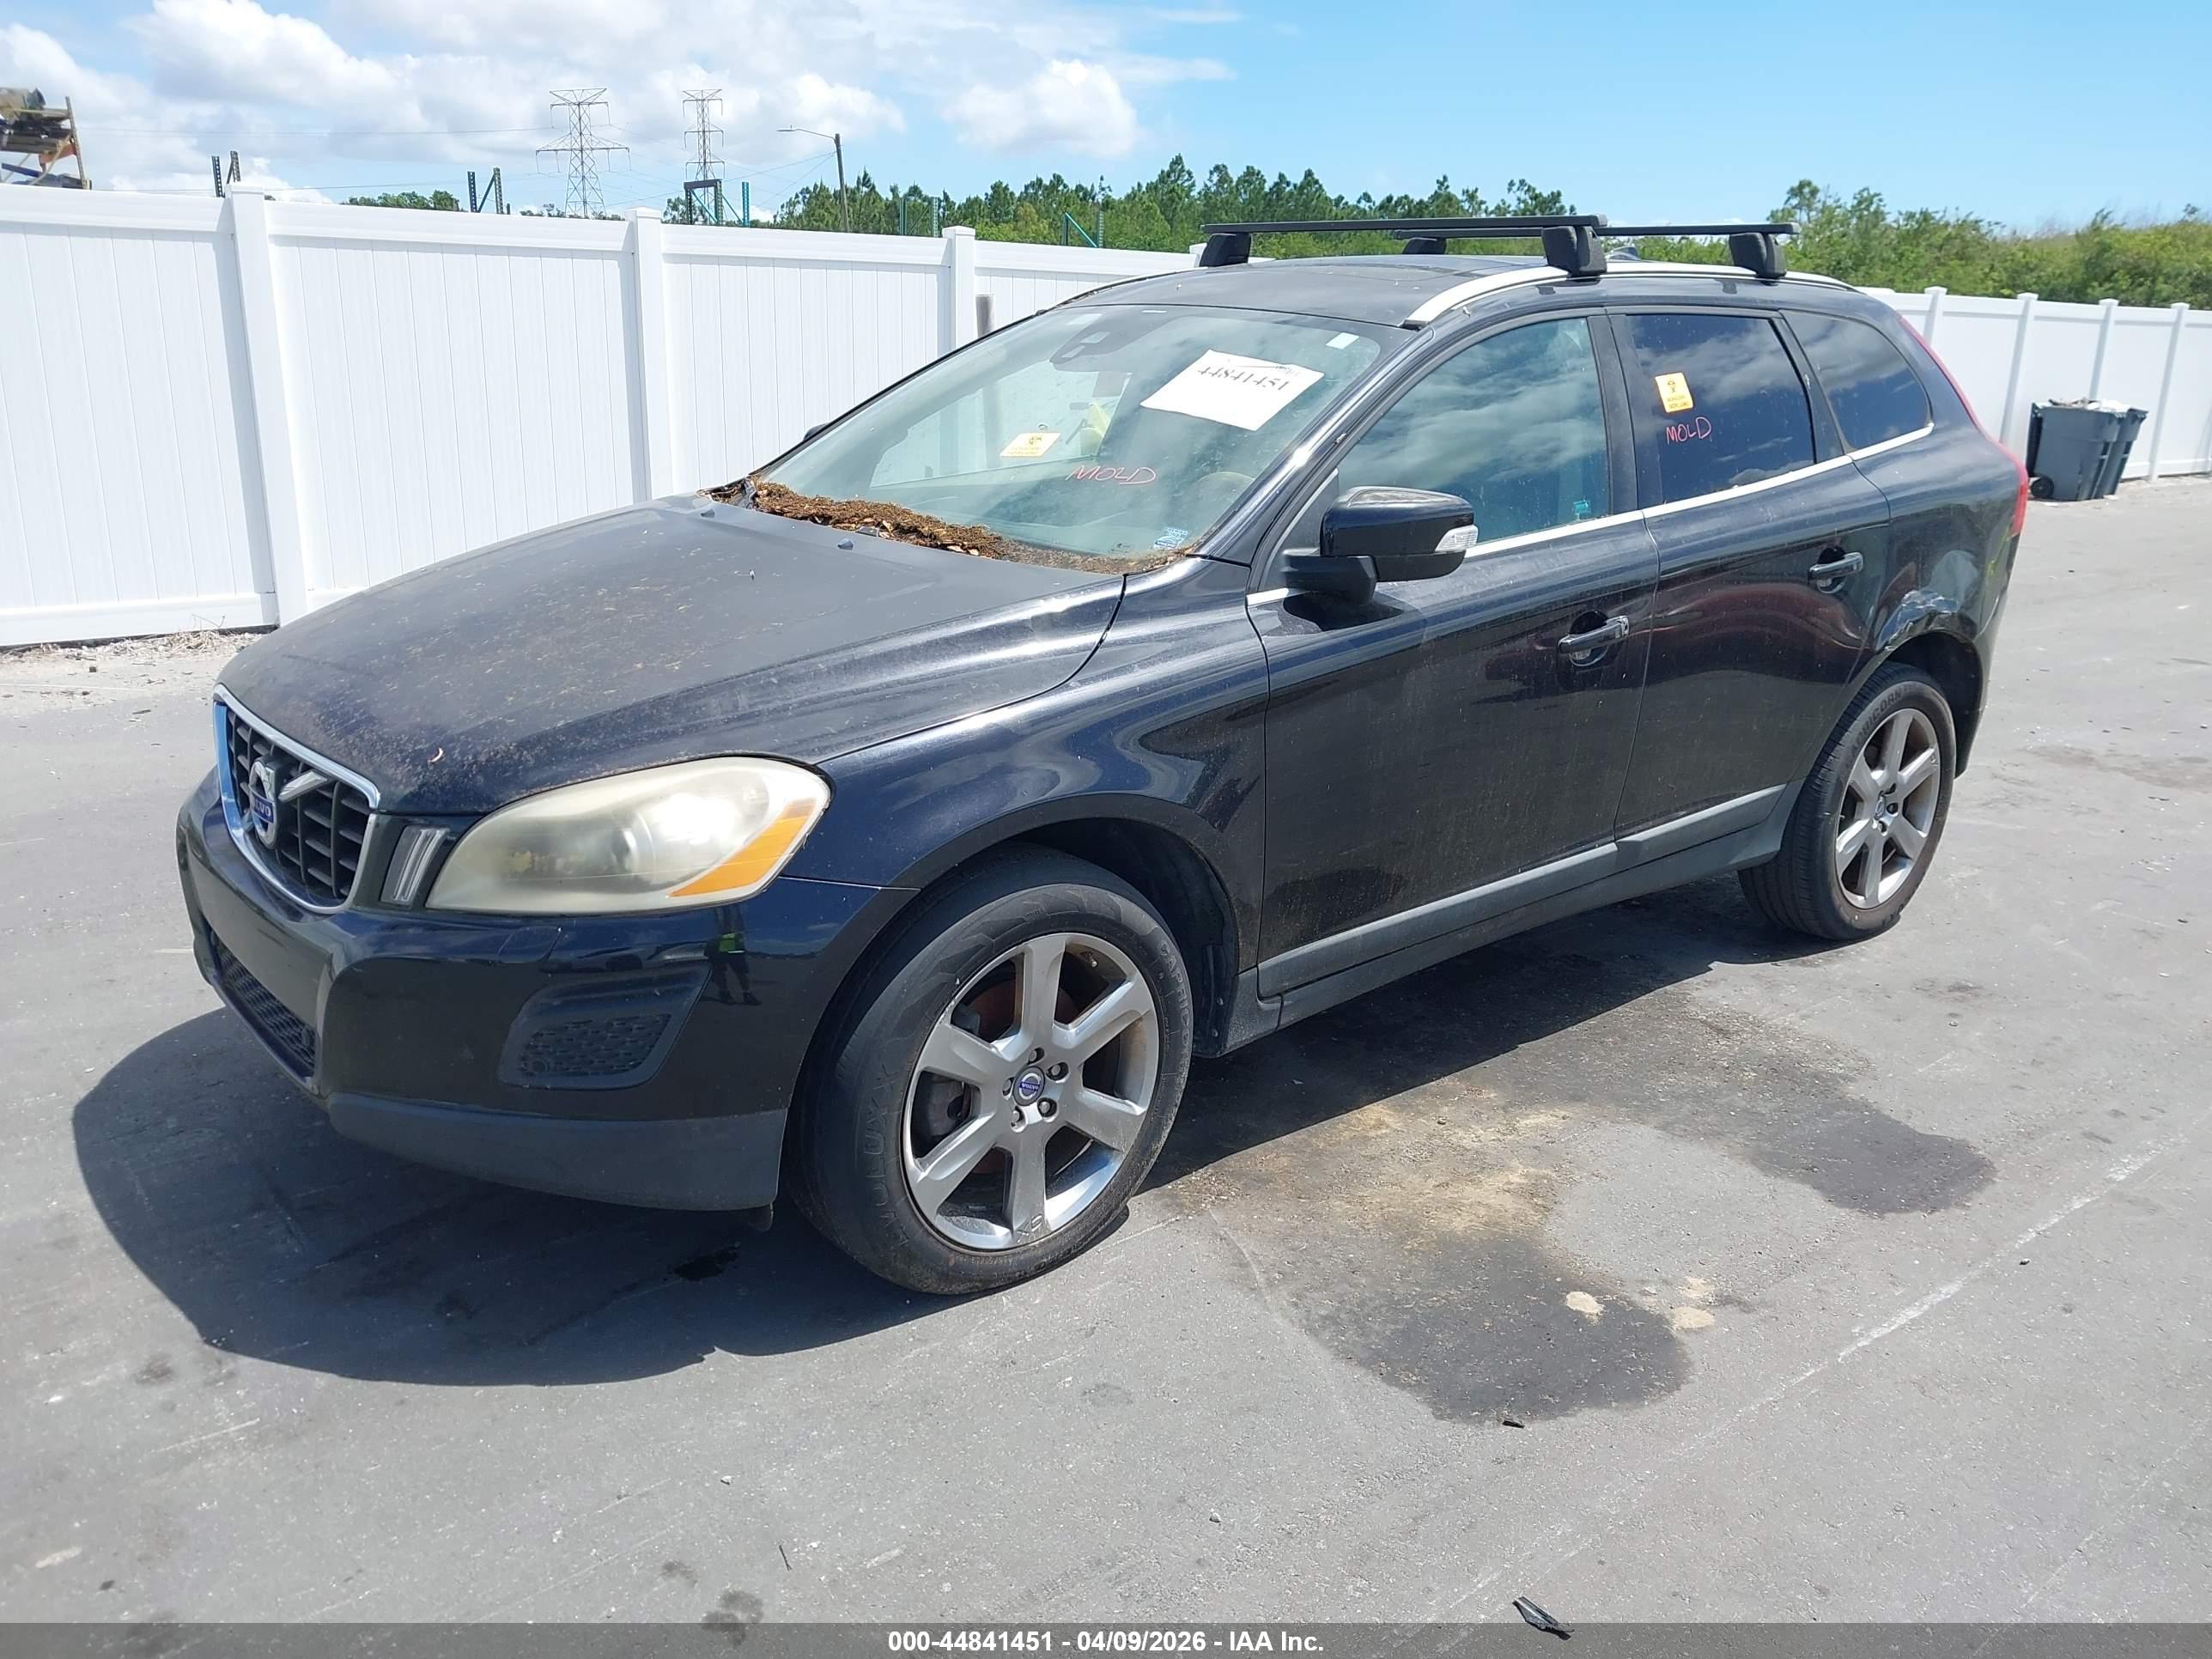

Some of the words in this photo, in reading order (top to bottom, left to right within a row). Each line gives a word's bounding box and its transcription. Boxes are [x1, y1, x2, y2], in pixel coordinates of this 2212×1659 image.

[1666, 416, 1711, 445] MOLD
[1065, 465, 1156, 485] MOLD
[1020, 1082, 1039, 1091] VOLVO
